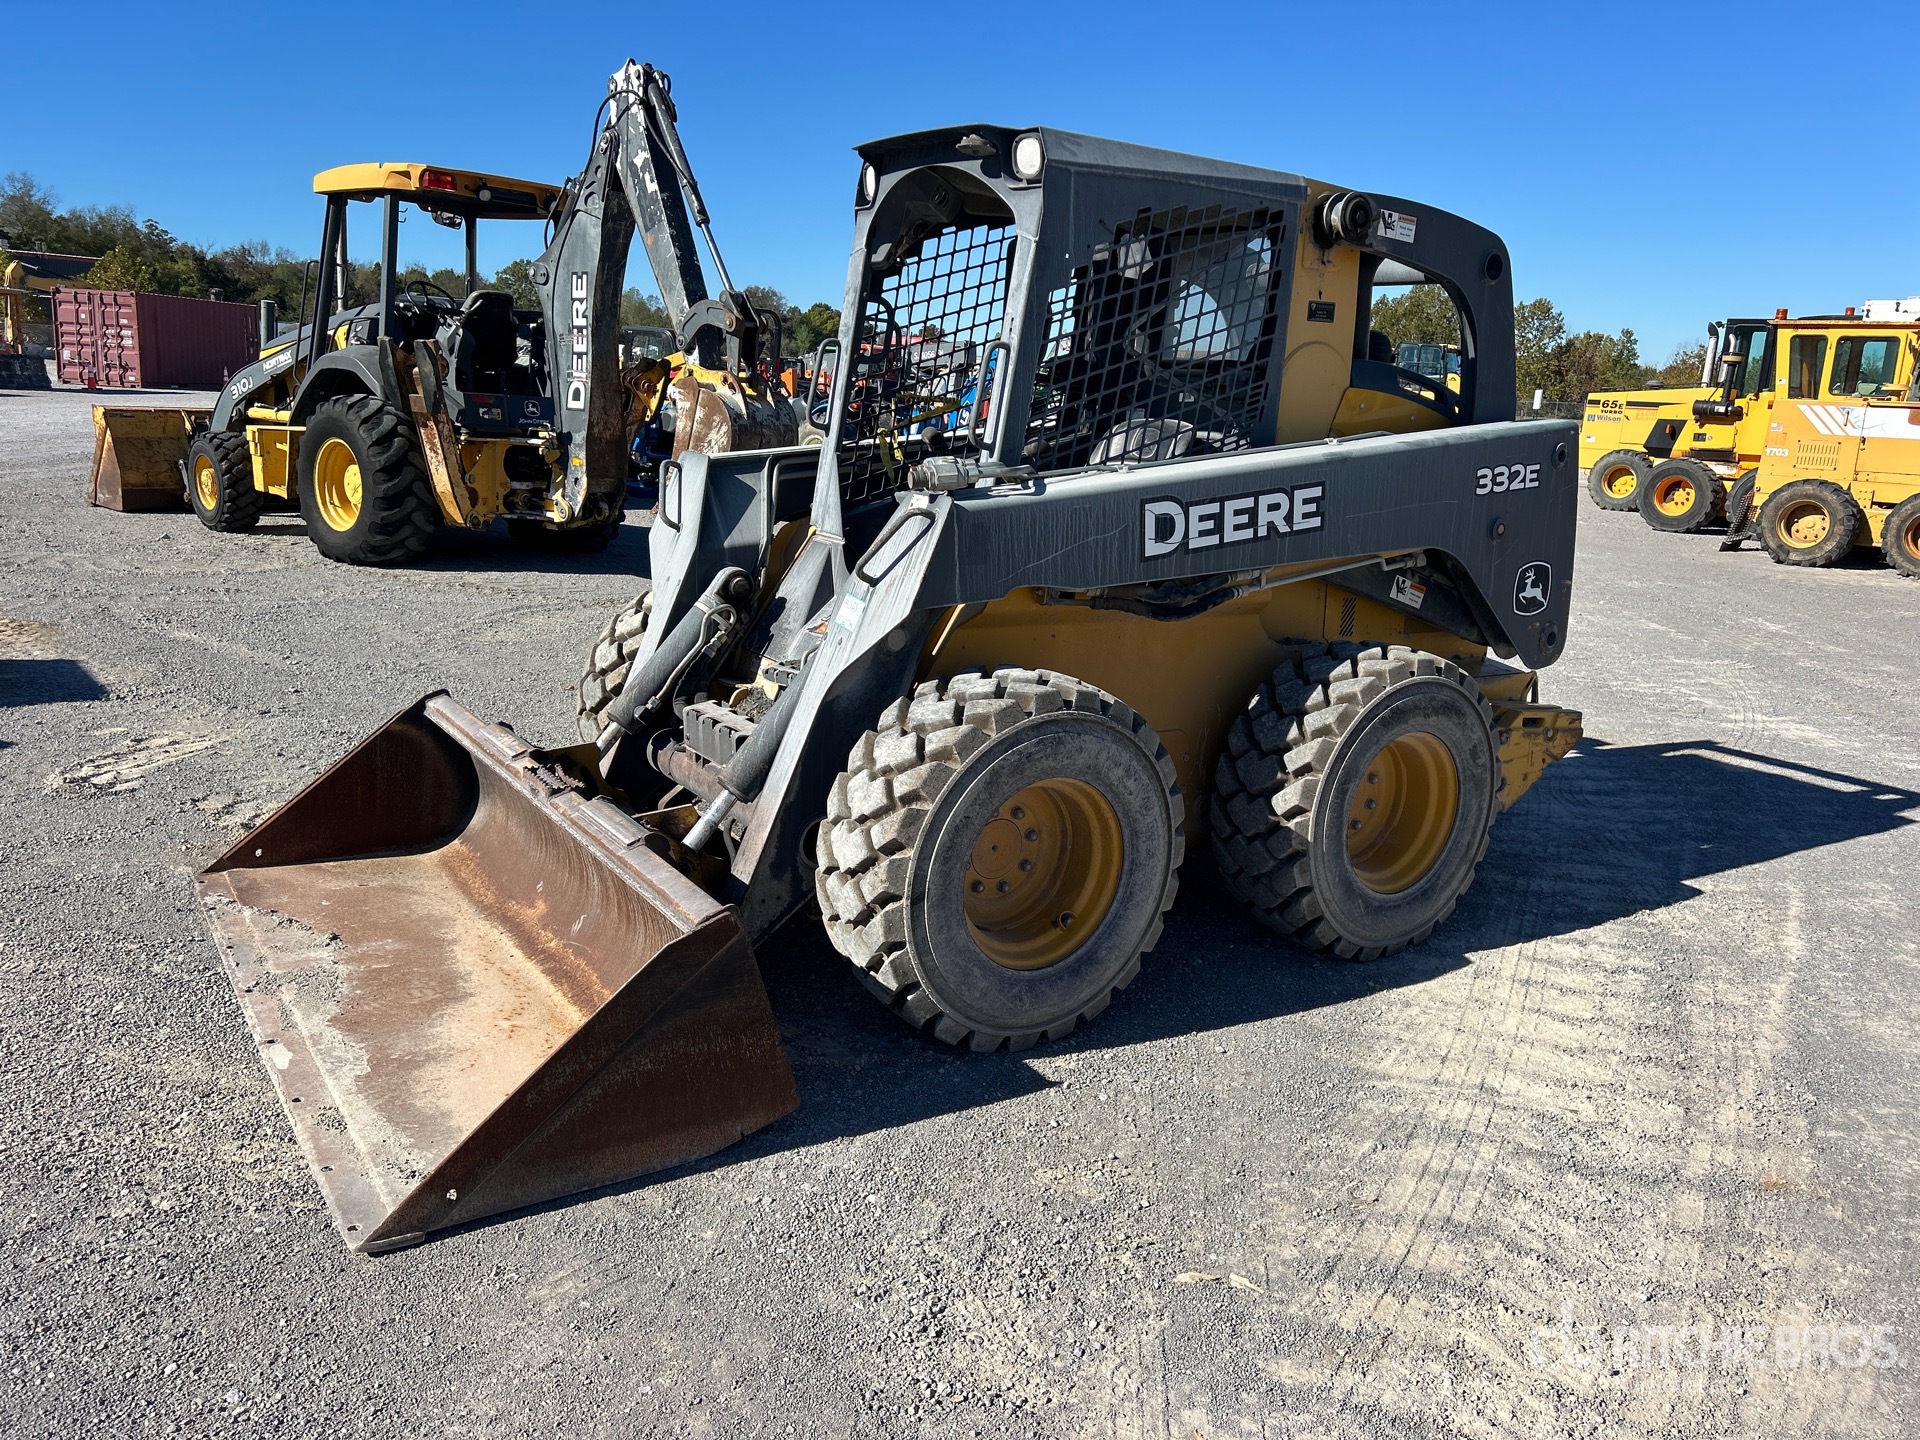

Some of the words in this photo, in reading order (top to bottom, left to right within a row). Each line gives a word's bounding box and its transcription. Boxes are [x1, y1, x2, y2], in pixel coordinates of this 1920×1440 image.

[566, 273, 588, 410] DEERE
[262, 350, 292, 371] NORTRAX
[913, 350, 935, 360] S1056
[230, 376, 254, 400] 310J
[1601, 400, 1624, 409] 65E
[1596, 414, 1621, 423] Wilson
[1475, 463, 1541, 495] 332E
[1144, 485, 1323, 558] DEERE
